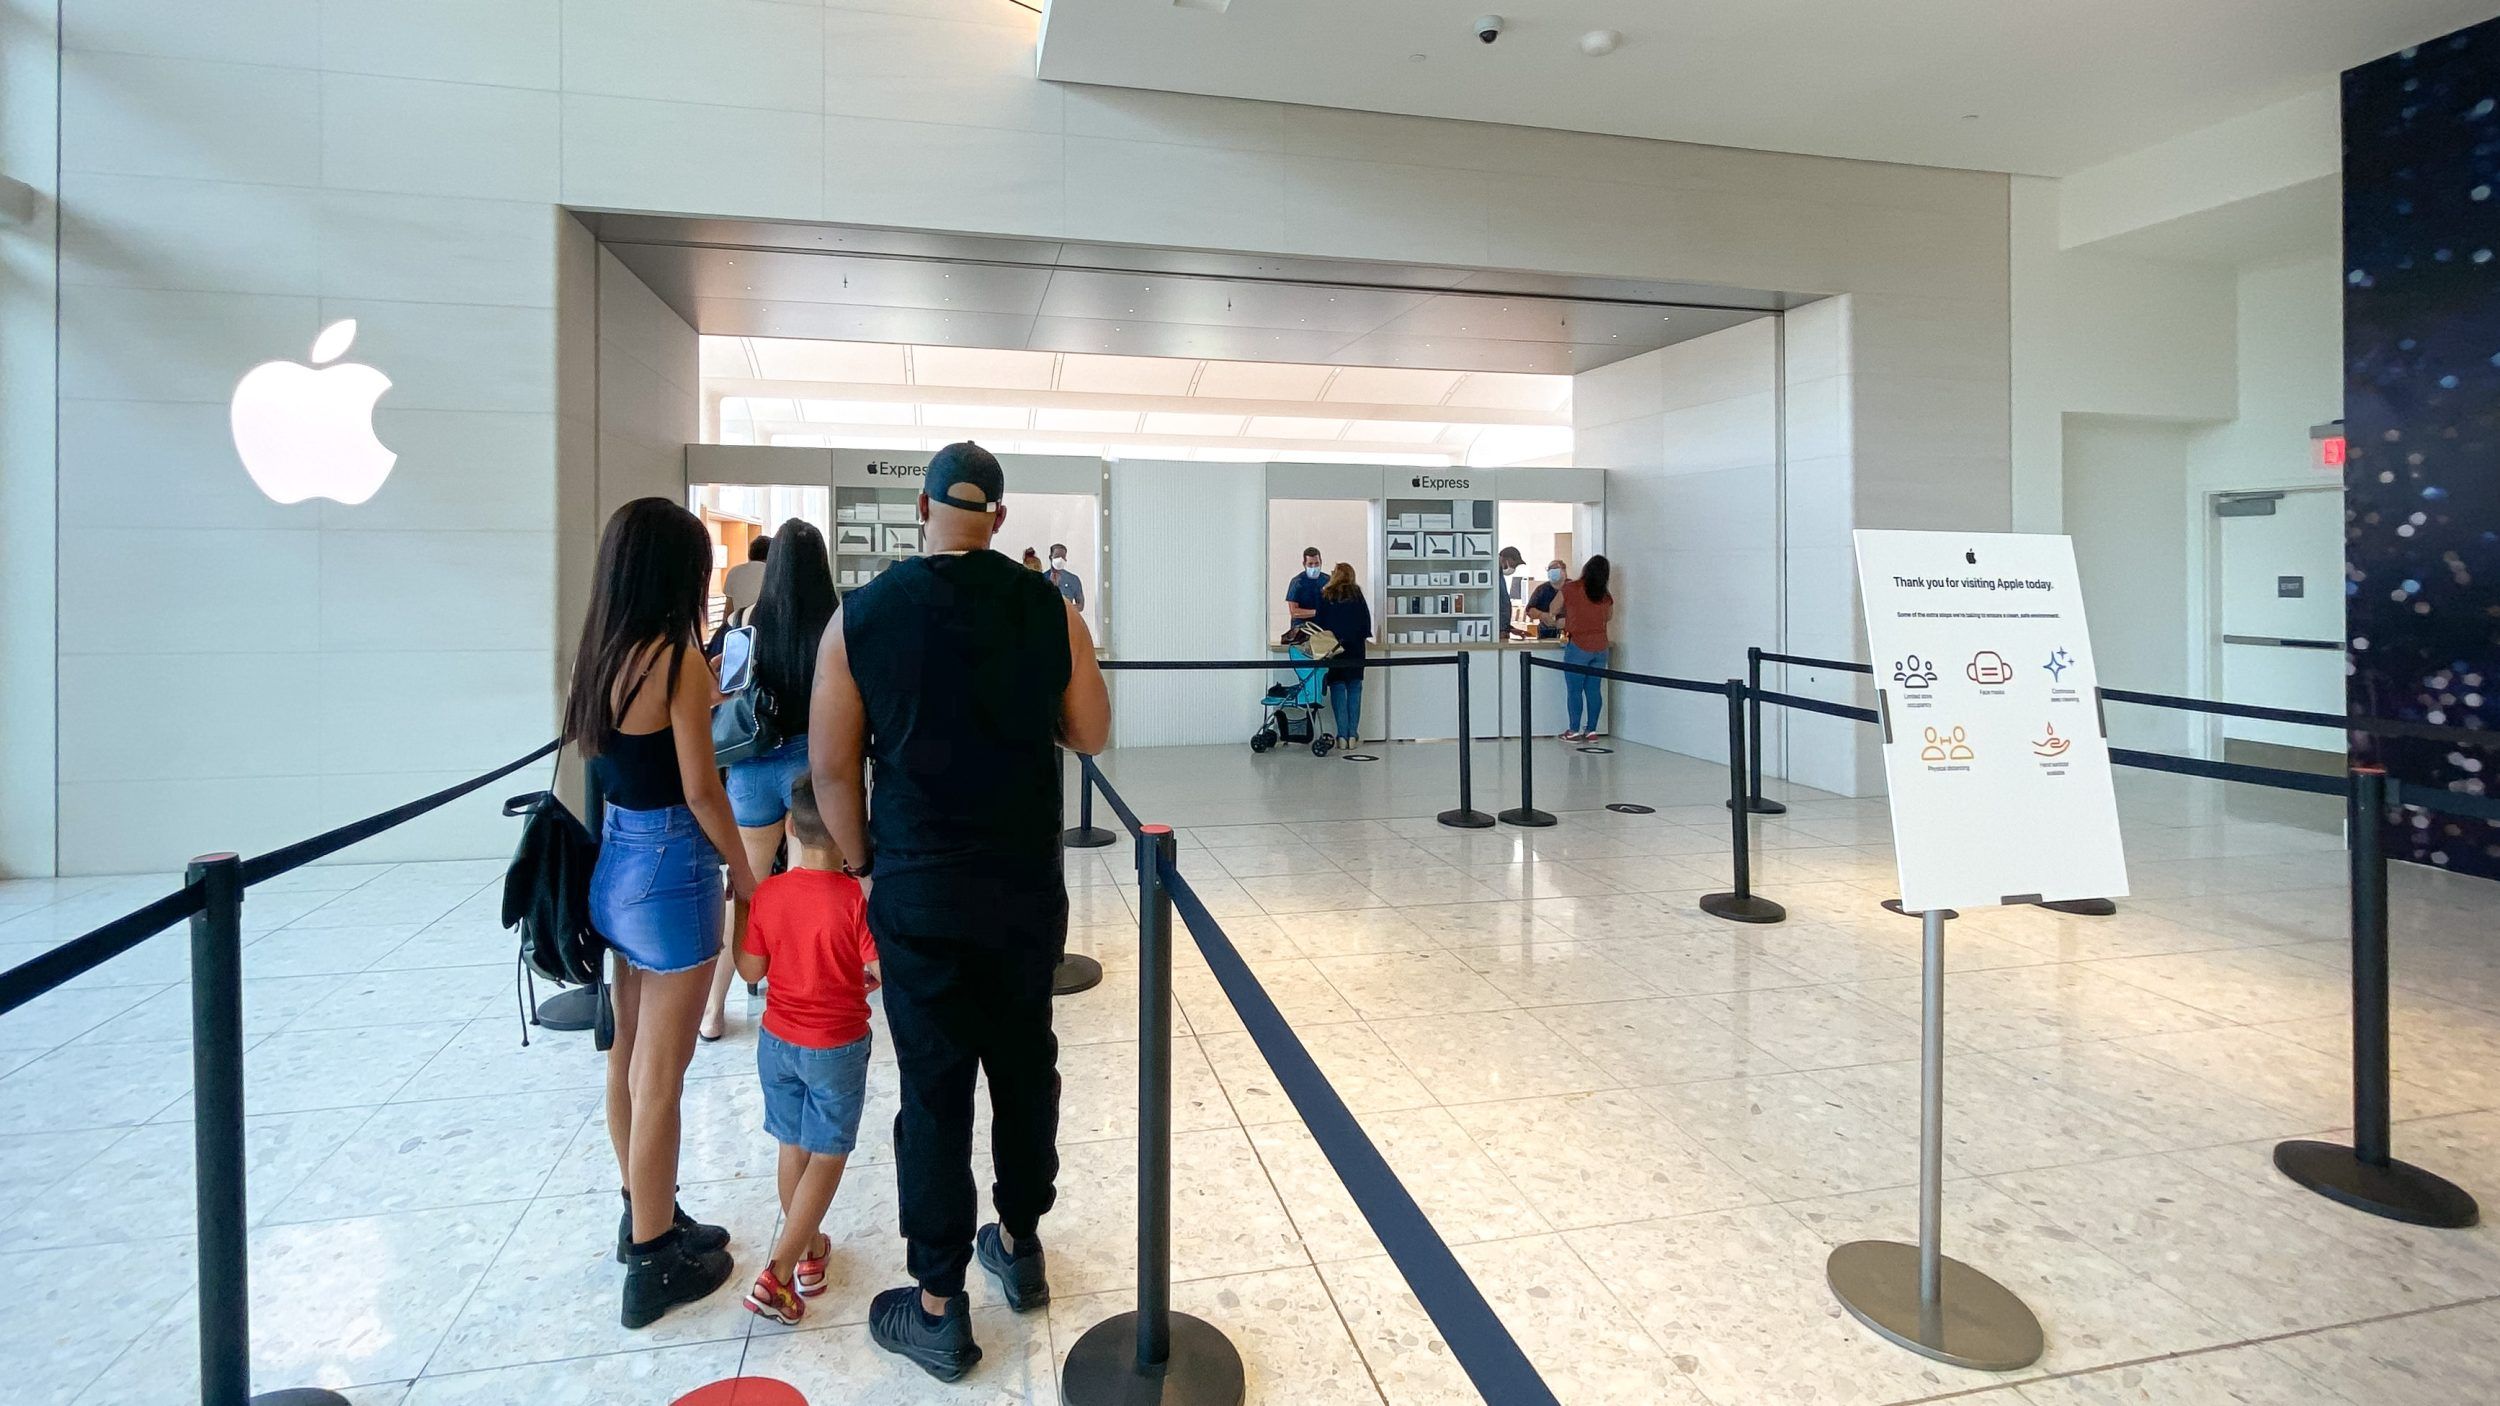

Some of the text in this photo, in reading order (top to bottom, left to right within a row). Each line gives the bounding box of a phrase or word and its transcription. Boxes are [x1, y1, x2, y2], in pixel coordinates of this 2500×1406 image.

[880, 461, 928, 478] Expres
[1422, 475, 1470, 491] Express
[1893, 576, 2054, 592] Thank you for visiting Apple today.
